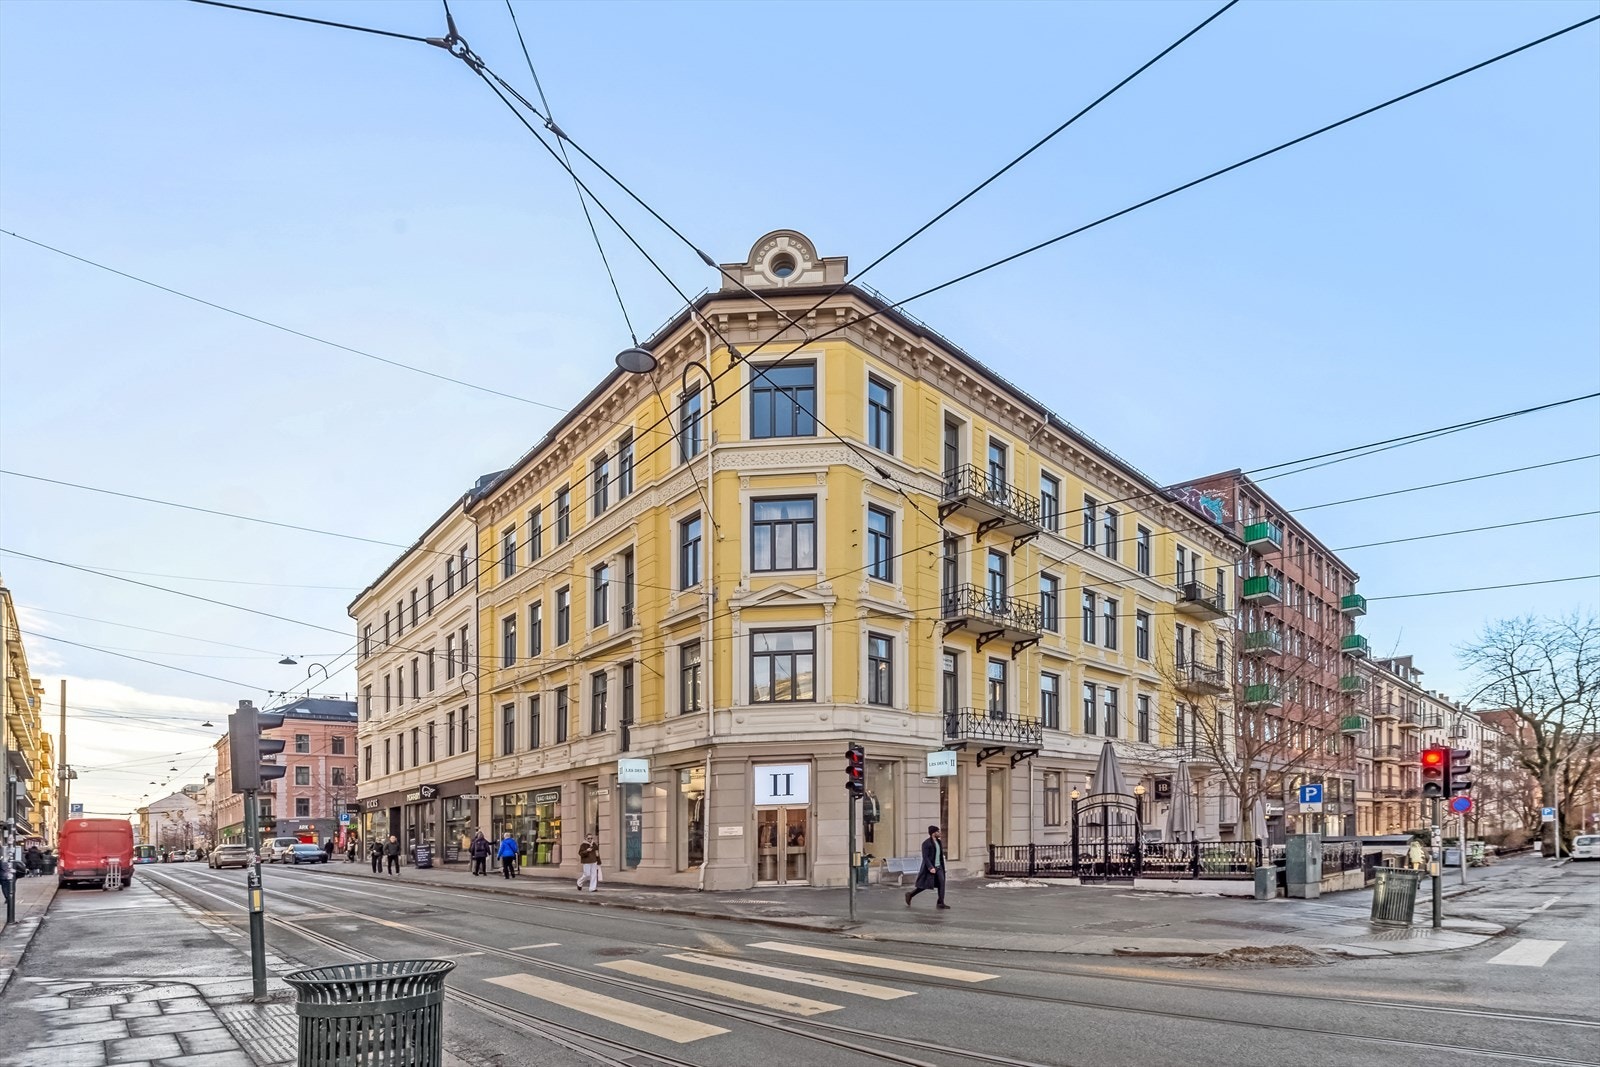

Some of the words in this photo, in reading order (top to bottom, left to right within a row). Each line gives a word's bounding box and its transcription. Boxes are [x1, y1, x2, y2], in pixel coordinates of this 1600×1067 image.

[769, 773, 794, 797] II
[1305, 787, 1318, 802] P
[73, 804, 80, 812] P
